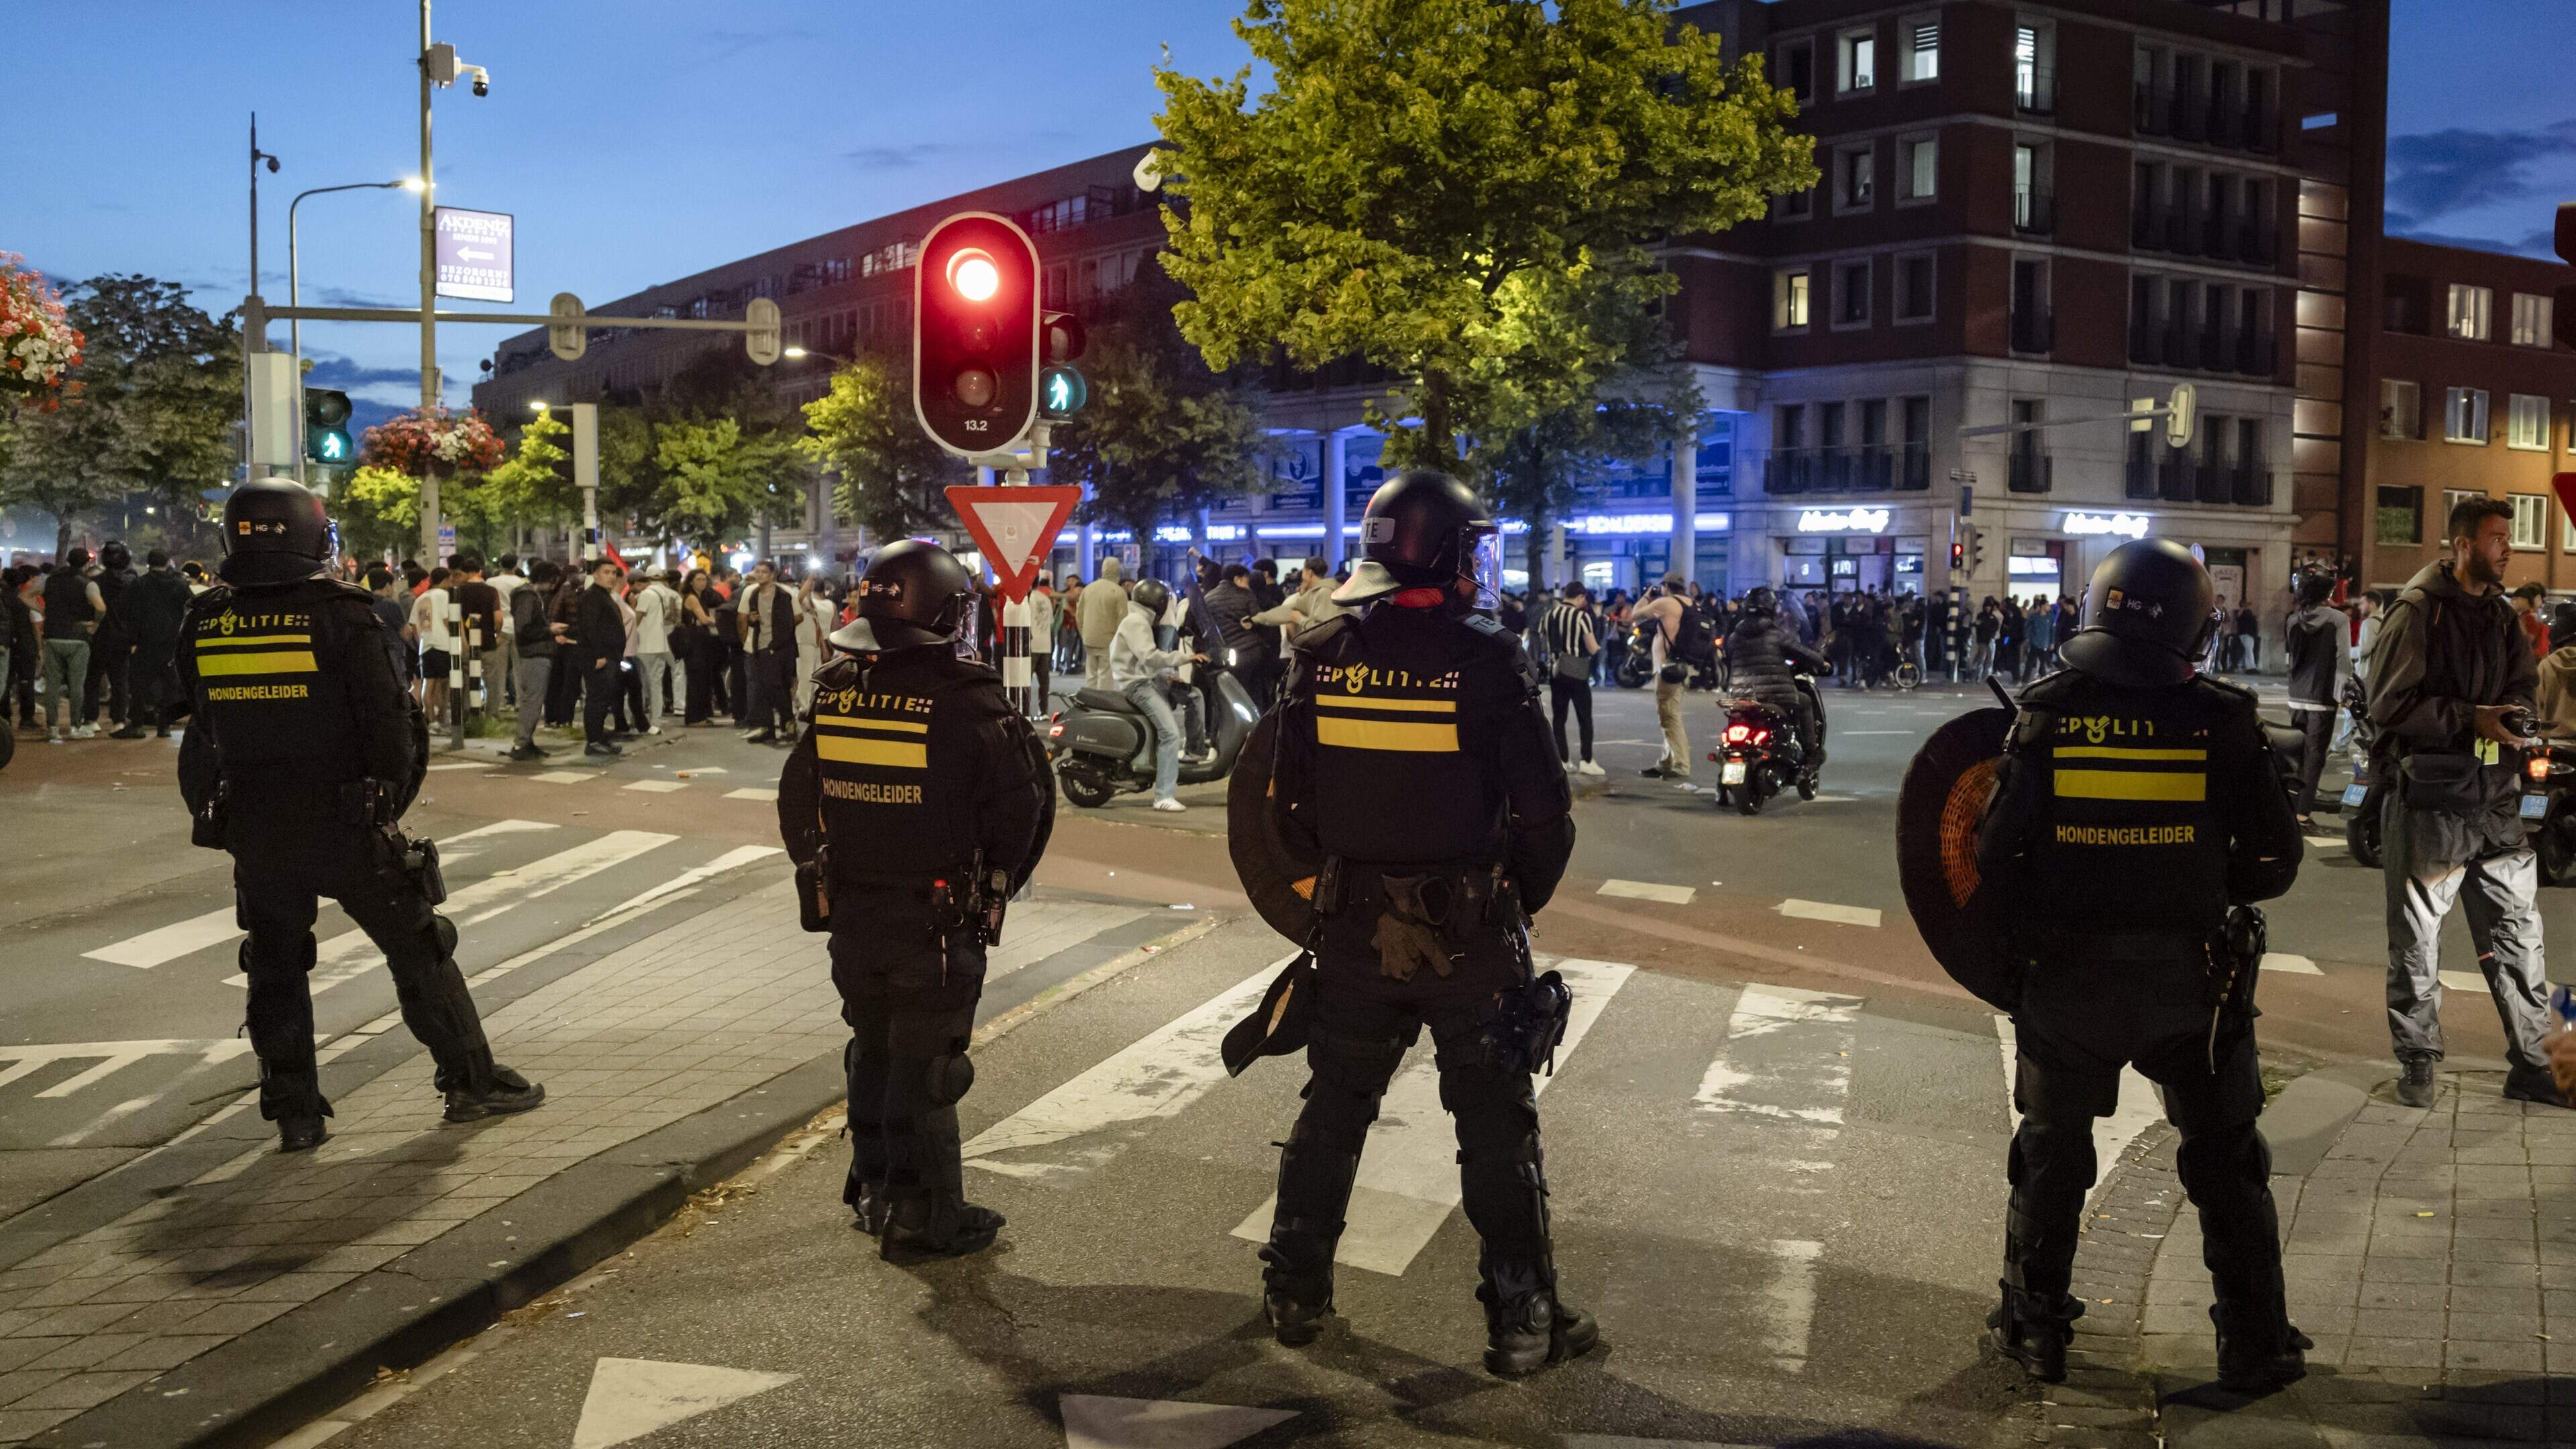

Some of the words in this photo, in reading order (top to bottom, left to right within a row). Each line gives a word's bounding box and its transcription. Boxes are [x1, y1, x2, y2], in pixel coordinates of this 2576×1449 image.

[964, 419, 988, 432] 13.2
[872, 584, 883, 593] HG
[2127, 600, 2142, 609] HG
[209, 606, 294, 635] POLITIE
[208, 684, 309, 701] HONDENGELEIDER
[829, 684, 916, 714] POLITIE
[822, 777, 922, 804] HONDENGELEIDER
[2056, 825, 2195, 845] HONDENGELEIDER
